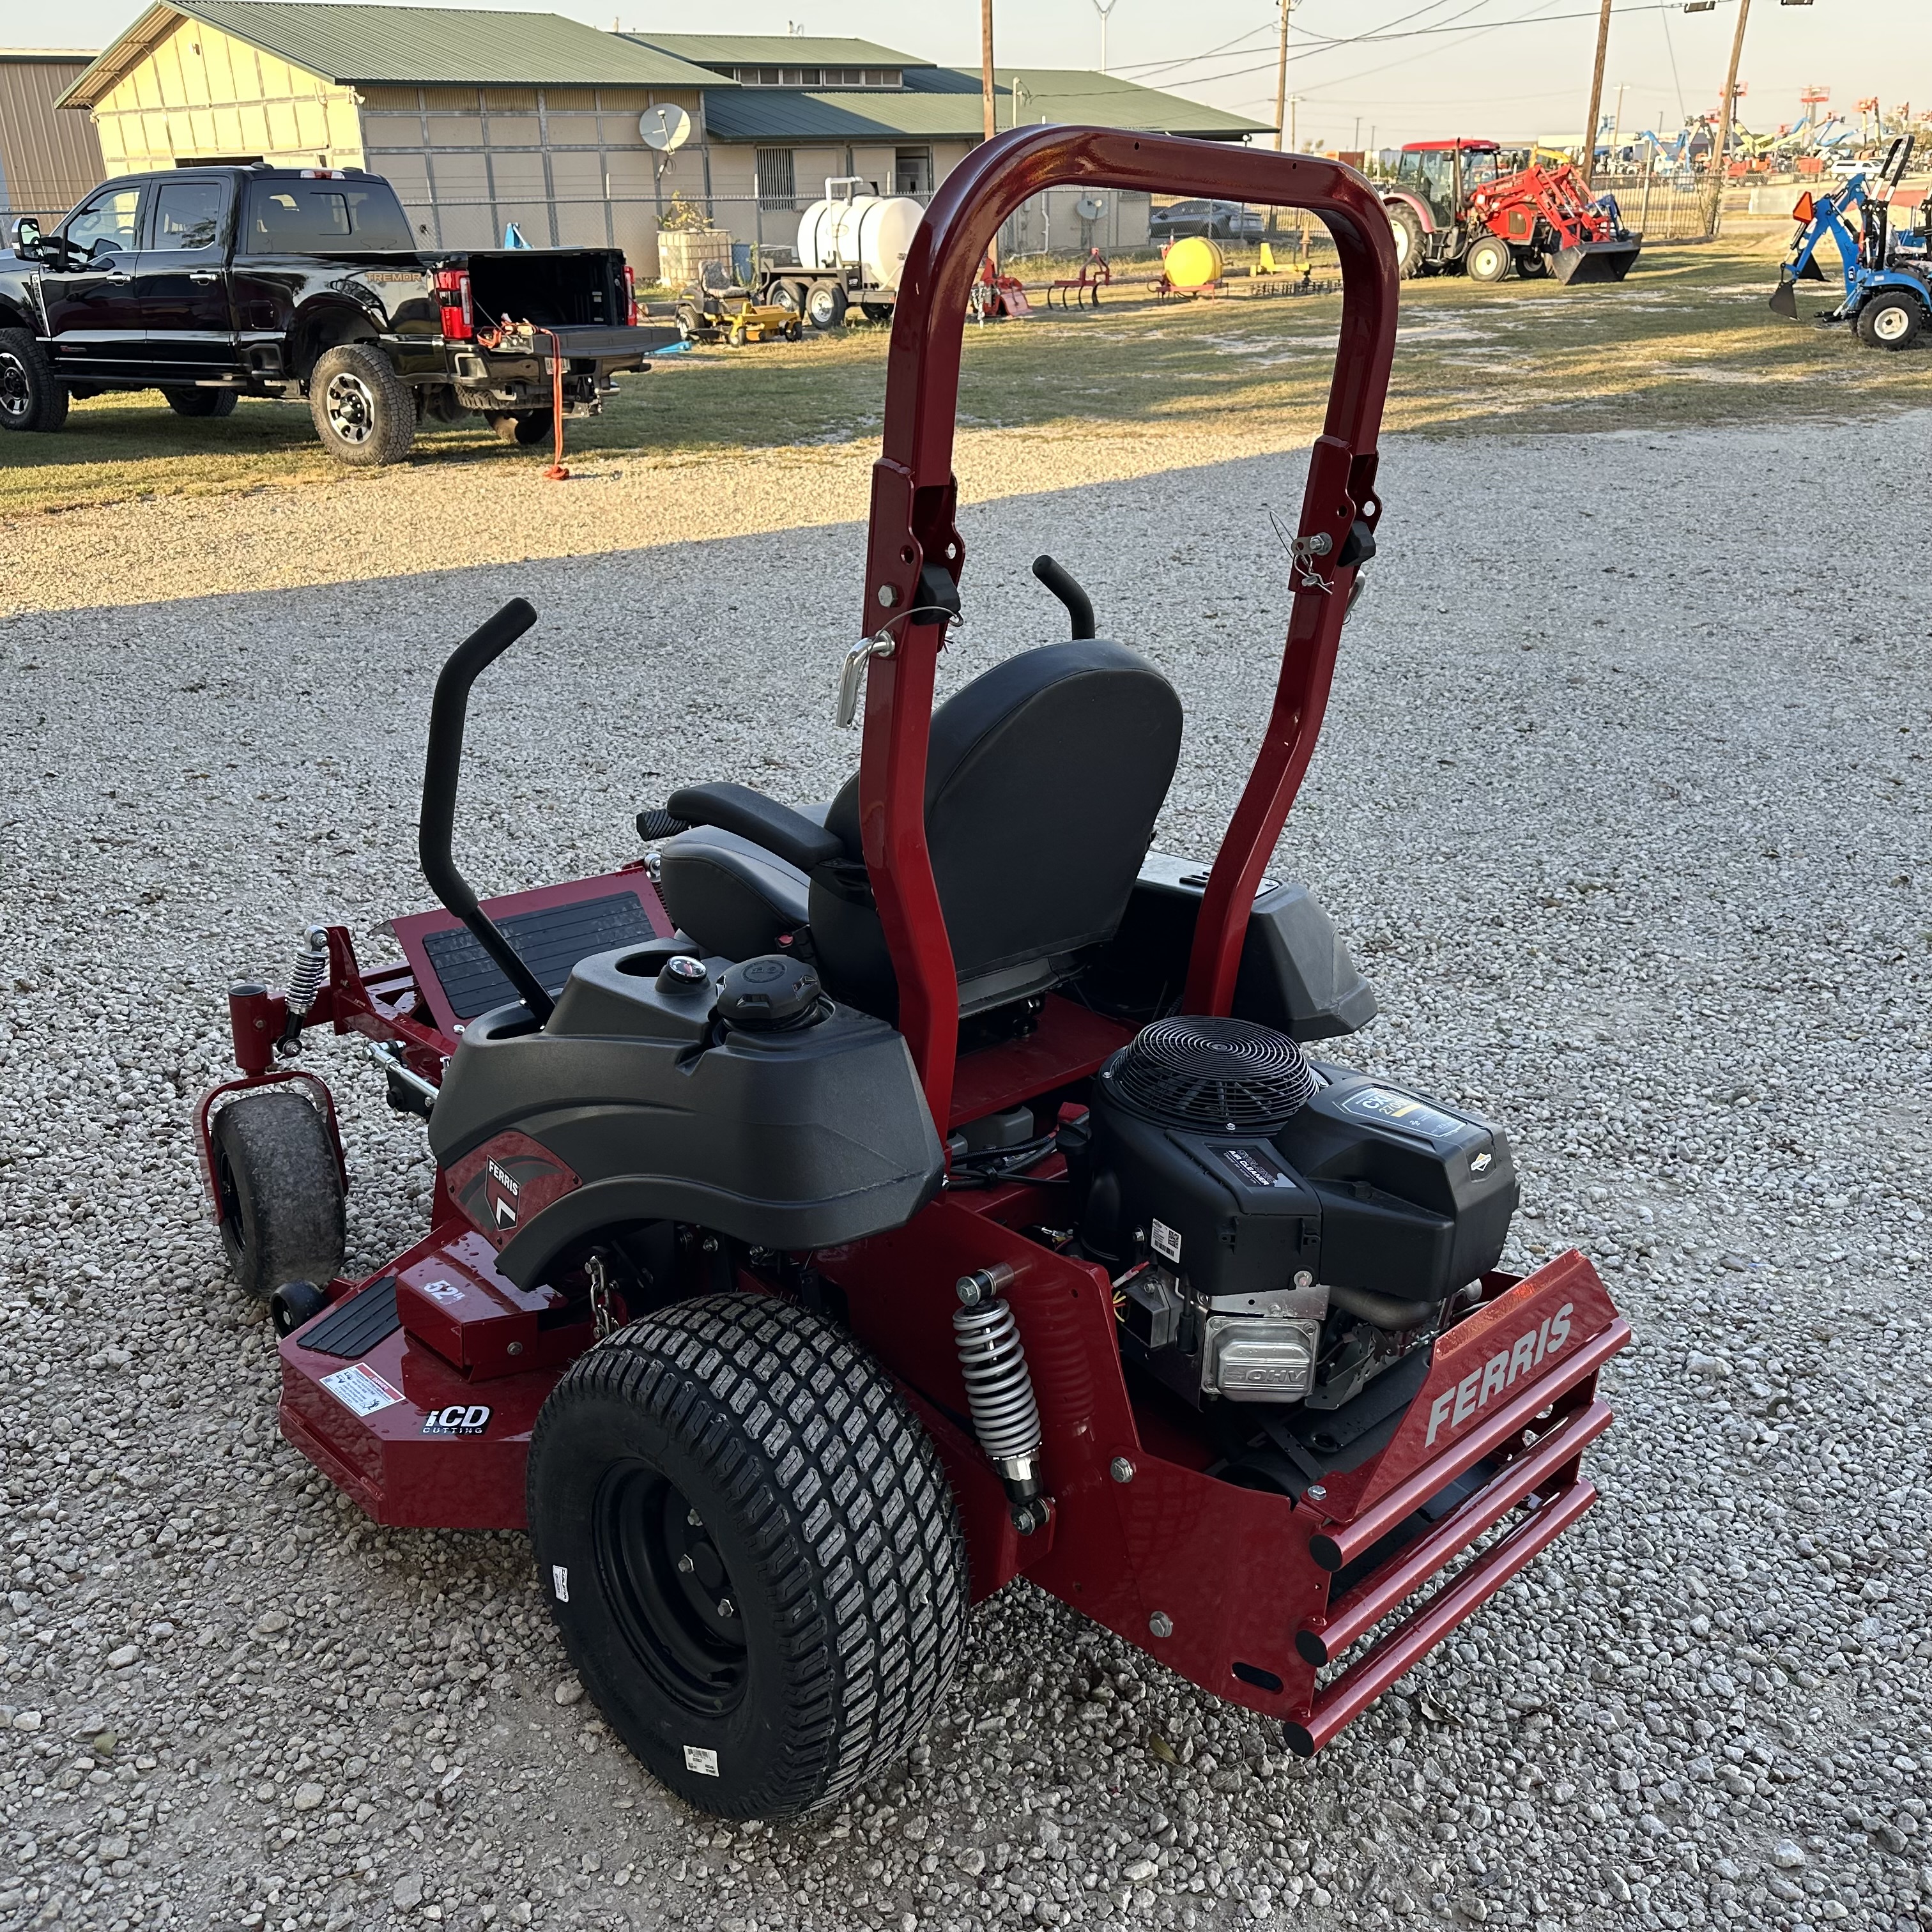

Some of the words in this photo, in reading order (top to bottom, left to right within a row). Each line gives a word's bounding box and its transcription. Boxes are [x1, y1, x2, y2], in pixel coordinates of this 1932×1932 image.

[365, 273, 422, 282] TREMOR
[1378, 1100, 1408, 1115] 2700
[489, 1160, 518, 1196] FERRIS
[1228, 1151, 1242, 1160] AIR
[1239, 1160, 1270, 1186] CLEANER
[424, 1280, 465, 1300] 52"
[371, 1377, 389, 1391] DANGER
[1246, 1369, 1307, 1383] OHV
[1425, 1302, 1574, 1448] FERRIS
[425, 1406, 490, 1427] iCD
